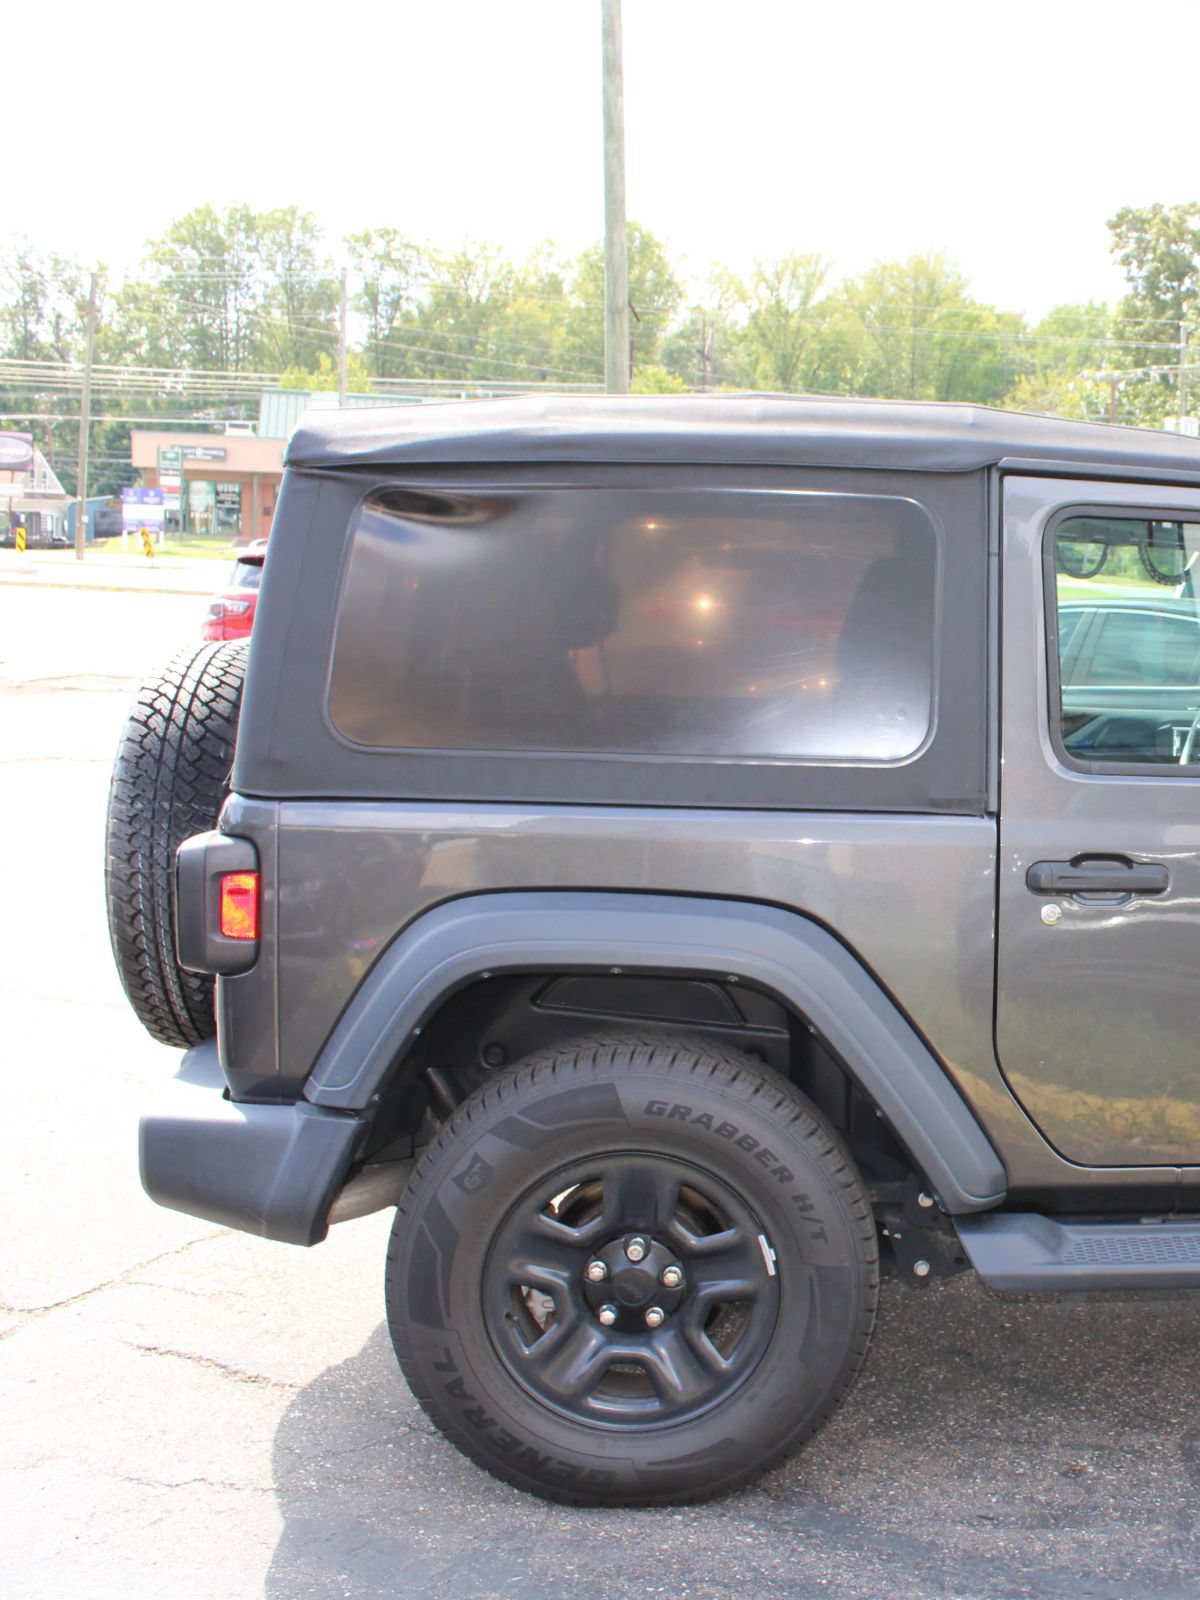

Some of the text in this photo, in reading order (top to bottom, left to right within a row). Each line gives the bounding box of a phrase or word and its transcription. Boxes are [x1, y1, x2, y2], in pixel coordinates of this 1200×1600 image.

[644, 1100, 829, 1244] GRABBER H/T
[433, 1347, 617, 1487] GENERAL
